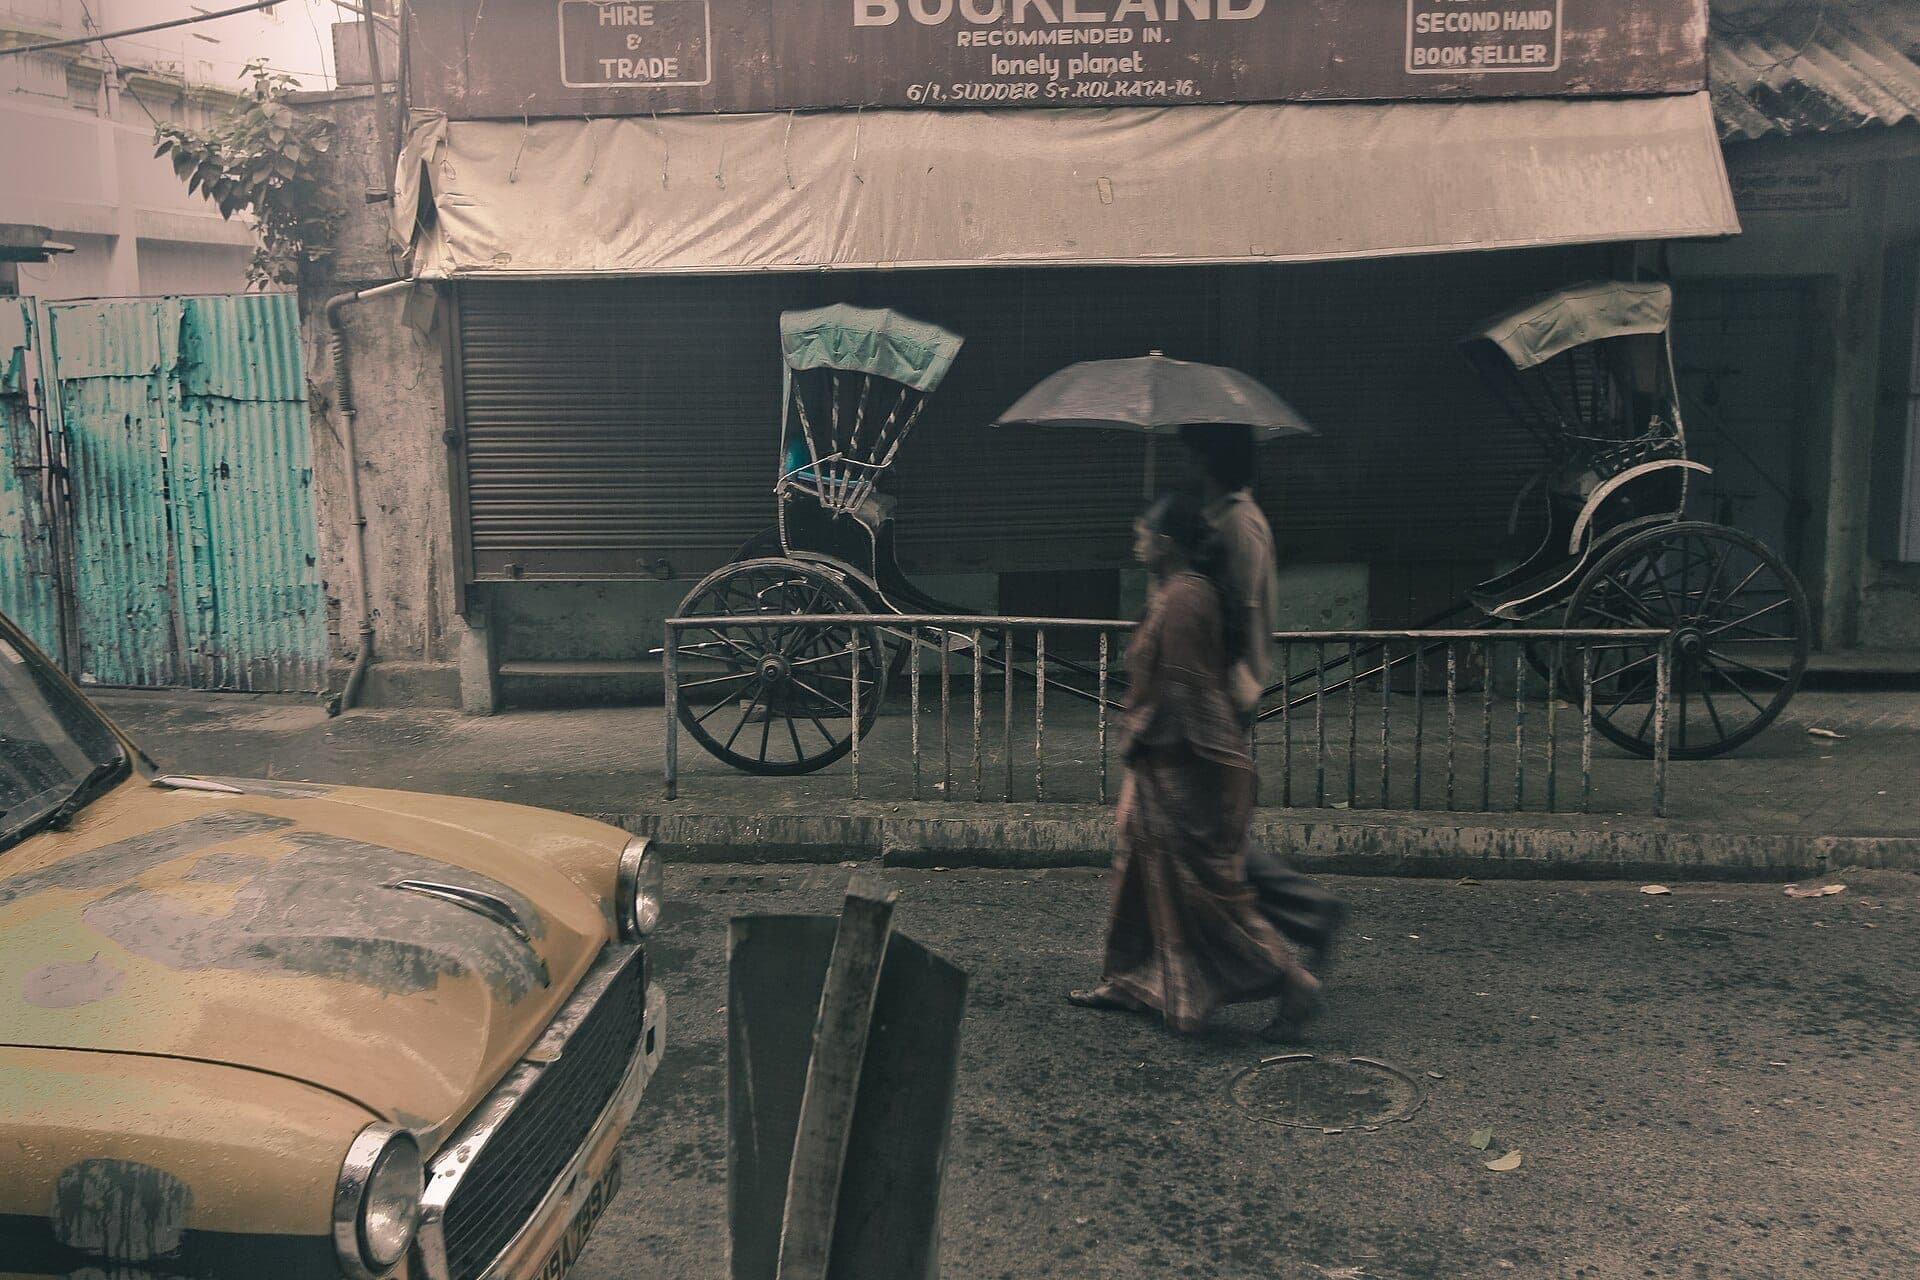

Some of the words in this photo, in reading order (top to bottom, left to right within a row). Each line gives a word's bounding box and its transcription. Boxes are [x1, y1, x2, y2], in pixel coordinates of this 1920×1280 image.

[599, 5, 655, 26] HIRE
[853, 0, 1265, 26] BOOKLAND
[1415, 11, 1500, 34] SECOND
[1503, 10, 1553, 31] HAND
[626, 33, 642, 50] &
[957, 28, 1134, 47] RECOMMENDED
[991, 52, 1060, 81] lonely
[1068, 50, 1145, 79] planet
[1413, 46, 1467, 66] BOOK
[1470, 44, 1548, 64] SELLER
[599, 57, 679, 79] TRADE
[951, 82, 1039, 100] SUDDER
